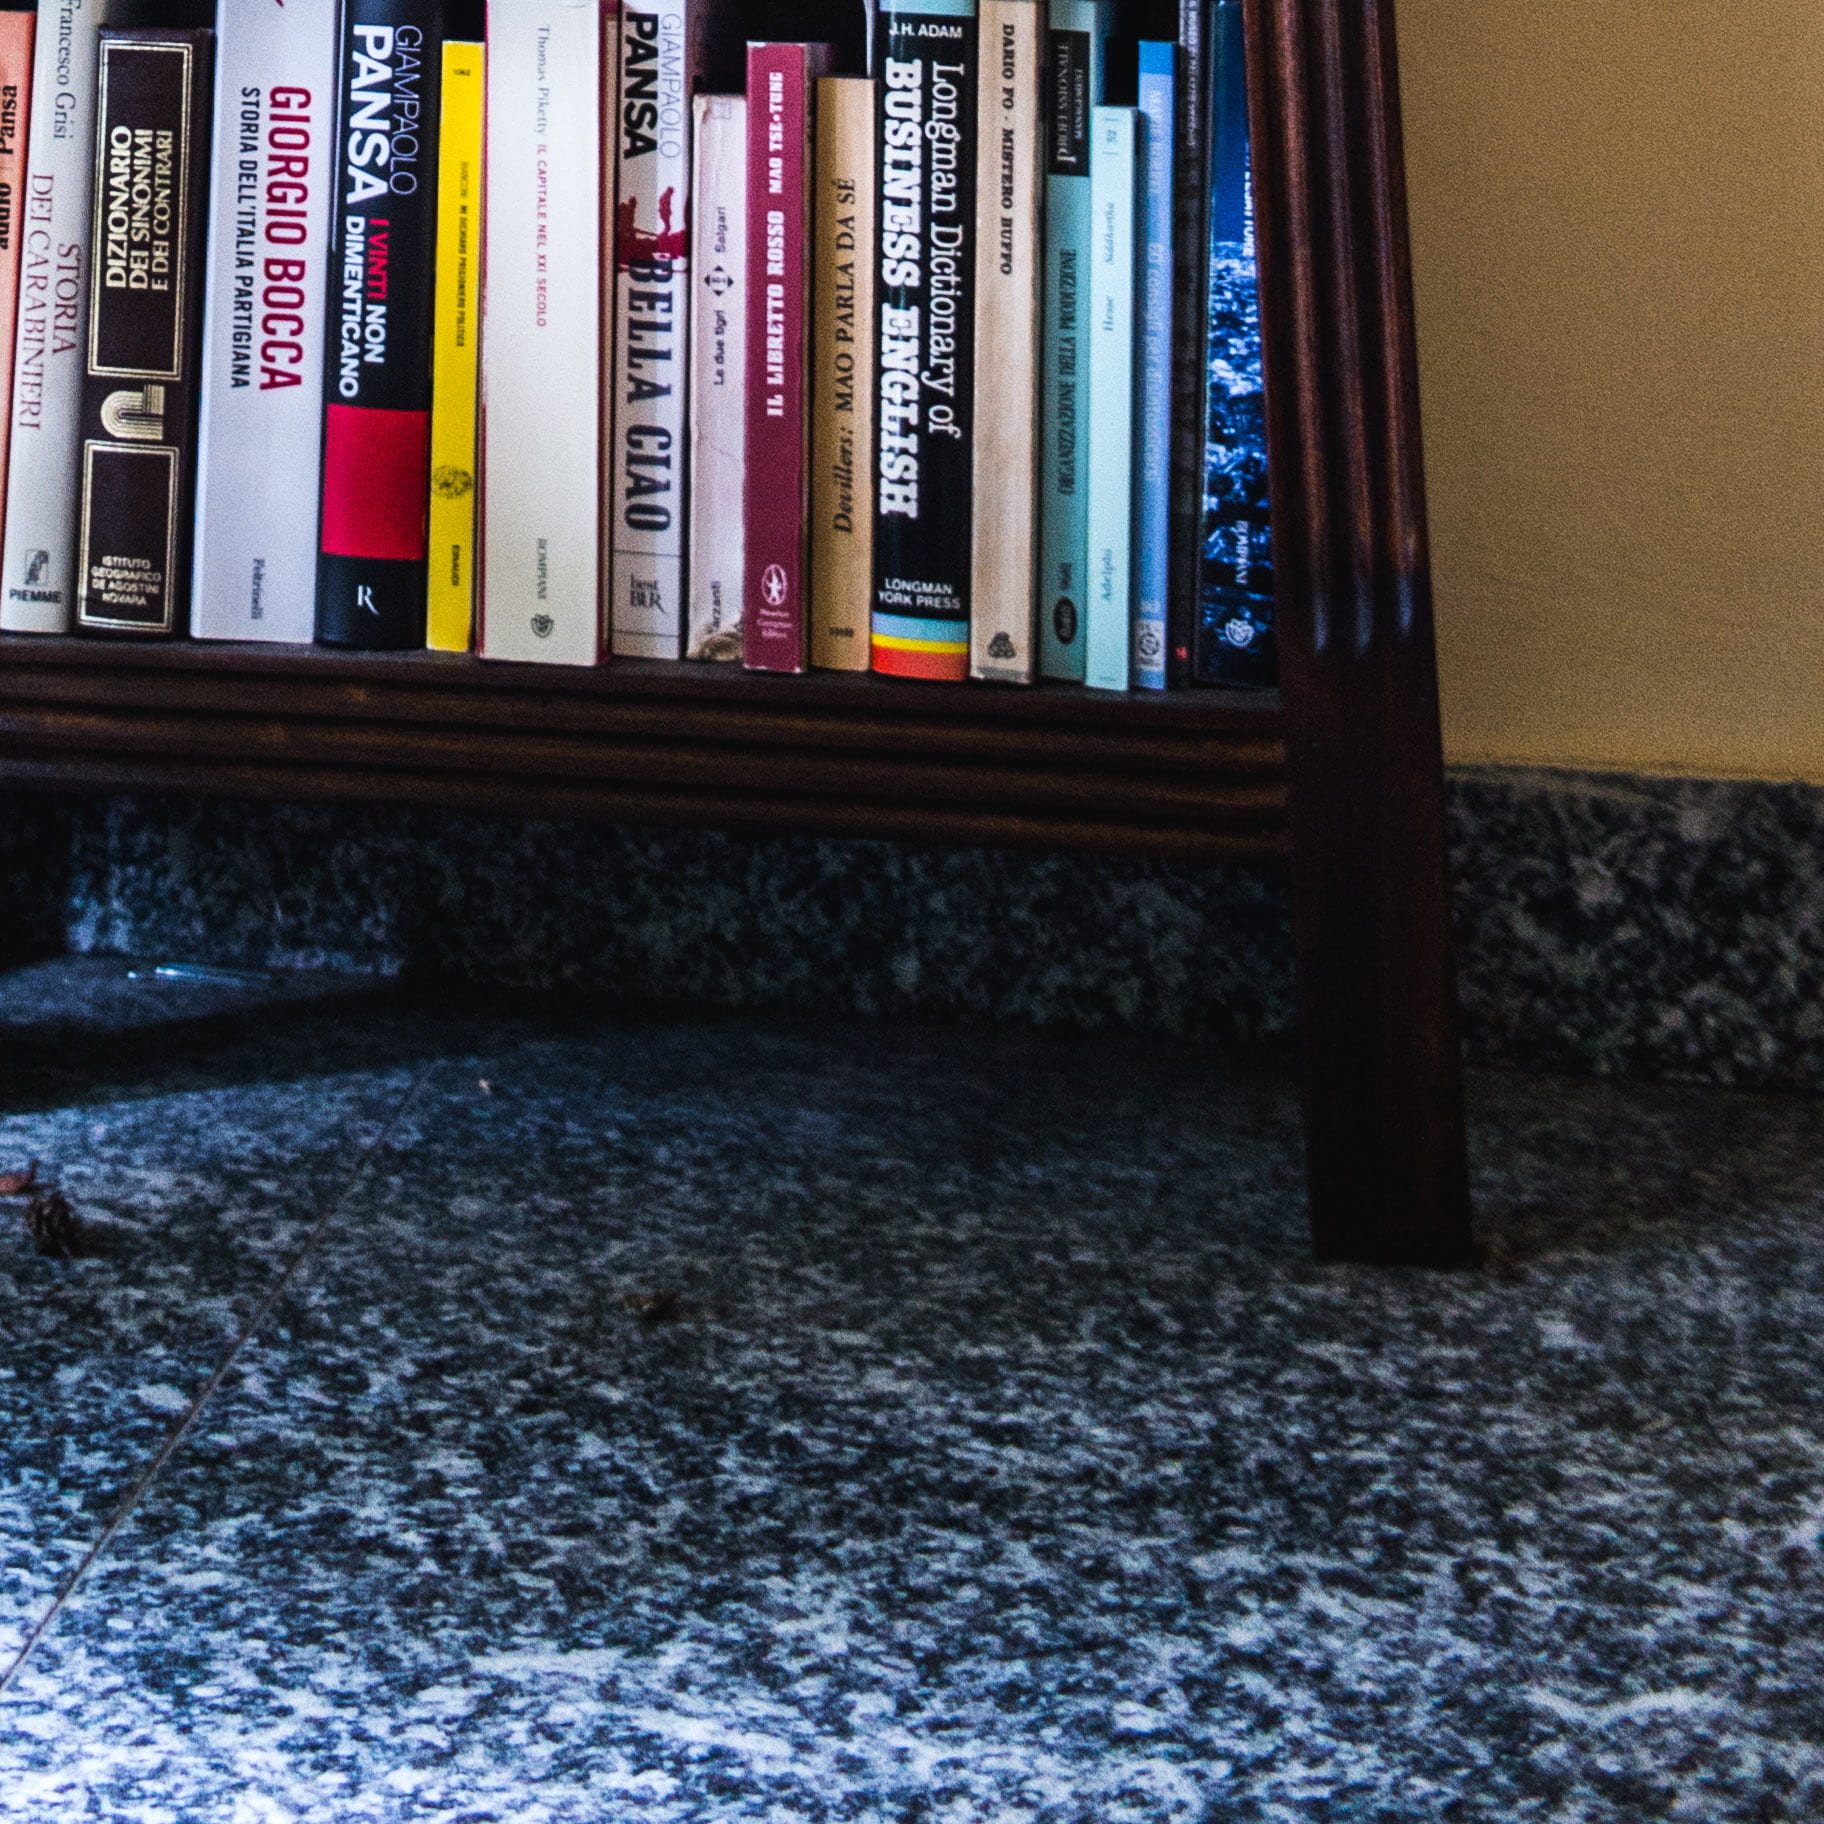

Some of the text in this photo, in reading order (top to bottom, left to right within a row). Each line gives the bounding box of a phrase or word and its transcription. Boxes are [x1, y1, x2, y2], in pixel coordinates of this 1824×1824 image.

[534, 24, 551, 134] Thomas Piketty
[621, 12, 659, 160] PANSA
[657, 12, 682, 160] GIAMPAOLO
[918, 24, 964, 39] ADAM
[51, 91, 80, 141] Grisi
[345, 23, 394, 204] PANSA
[389, 24, 423, 196] GIAMPAOLO
[1000, 23, 1016, 275] DARIO FO MISTERO BUFFO
[105, 125, 132, 289] DIZIONARIO
[128, 128, 154, 290] DEI SINONIMI
[230, 86, 262, 390] STORIA DELL'ITALIA PARTIGIANA
[260, 85, 312, 392] GIORGIO BOCCA
[713, 206, 729, 254] Salgari
[921, 60, 965, 439] Longman Dictionary of
[16, 172, 56, 431] DEI CARABINIERI
[53, 242, 83, 357] STORIA
[339, 214, 365, 398] DIMENTICANO
[712, 309, 728, 386] Le due tigri
[880, 57, 923, 519] BUSINESS ENGLISH
[624, 254, 677, 533] BELLA CIAO
[8, 588, 63, 604] PIEMME
[91, 577, 161, 595] DE AGOSTINI
[101, 555, 152, 570] ISTITUTO
[101, 591, 148, 607] NOVARA
[450, 544, 462, 587] EINAUDI
